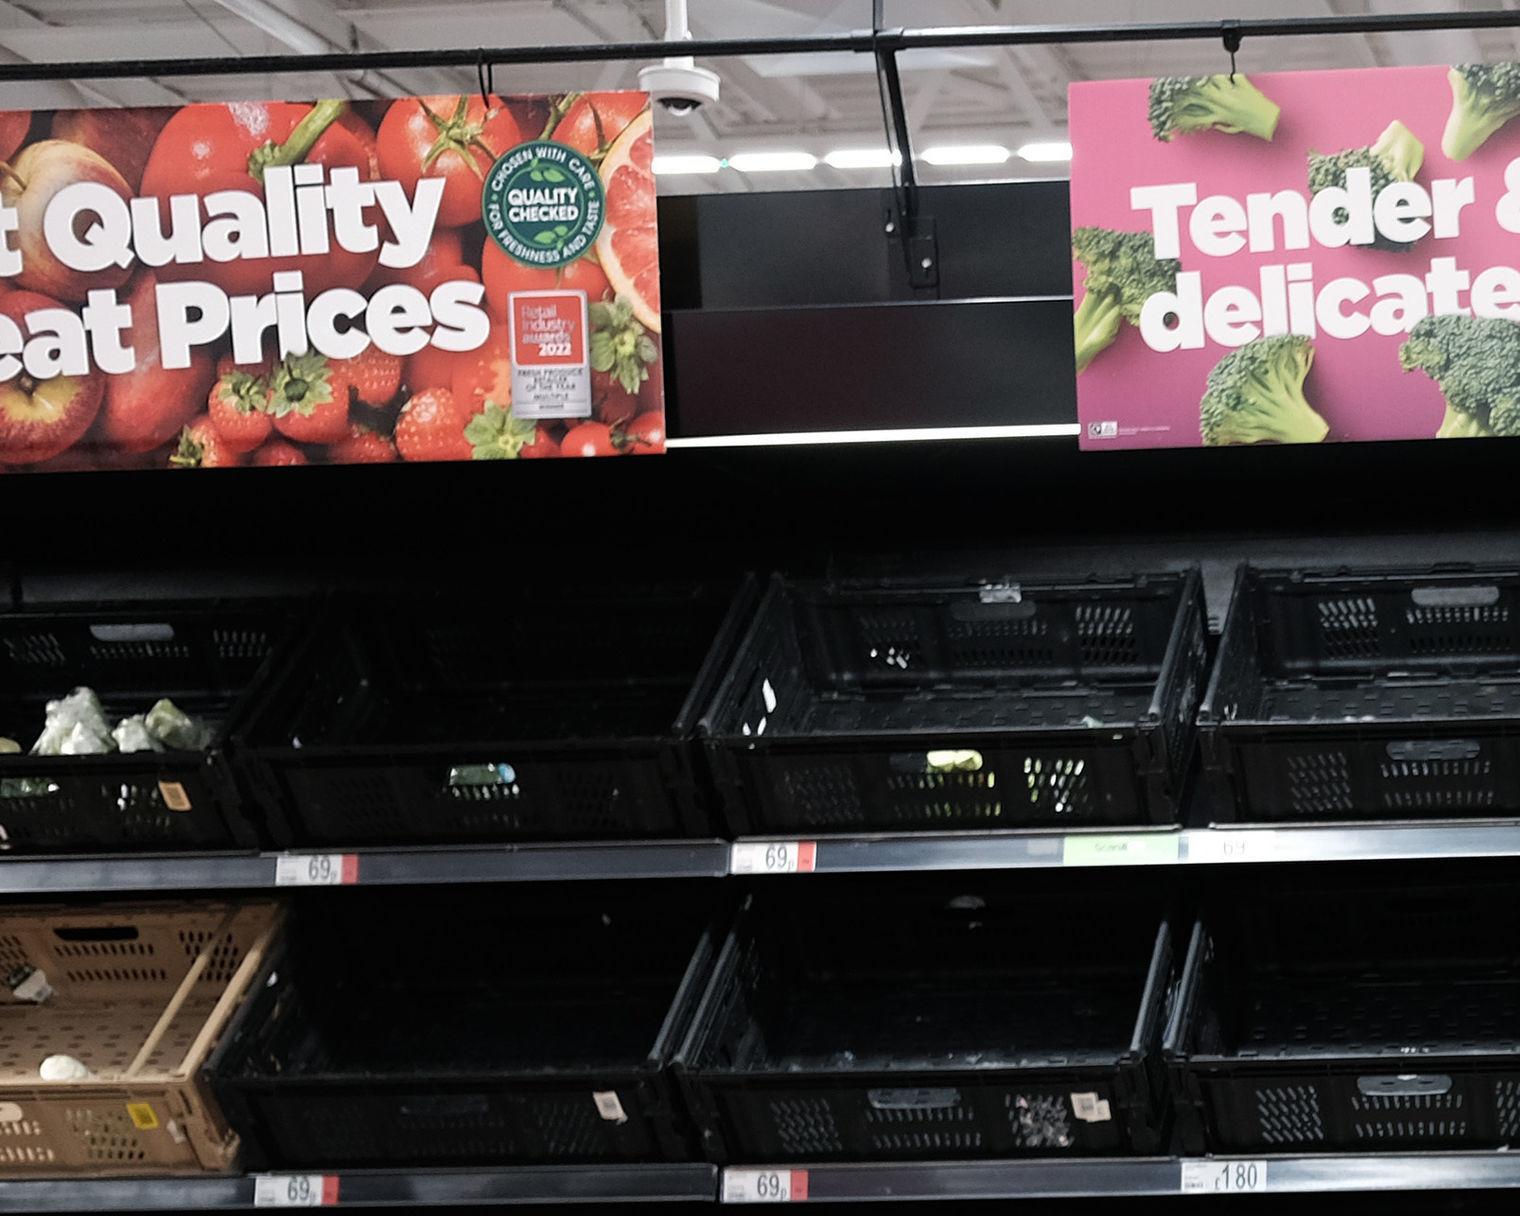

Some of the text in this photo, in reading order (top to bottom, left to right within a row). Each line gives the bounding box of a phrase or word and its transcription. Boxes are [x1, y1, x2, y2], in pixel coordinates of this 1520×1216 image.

[490, 146, 597, 192] CHOSEN WITH CARE
[507, 187, 579, 207] QUALITY
[43, 164, 447, 269] Quality
[507, 204, 580, 223] CHECKED
[1130, 166, 1476, 261] Tender
[487, 199, 601, 264] FOR FRESHNESS AND TASTE
[155, 270, 491, 372] Prices
[521, 303, 558, 320] Retail
[538, 342, 573, 356] 2022
[308, 856, 338, 884] 69p
[765, 845, 794, 871] 69p
[287, 1176, 317, 1205] 69p
[756, 1173, 788, 1200] 69p
